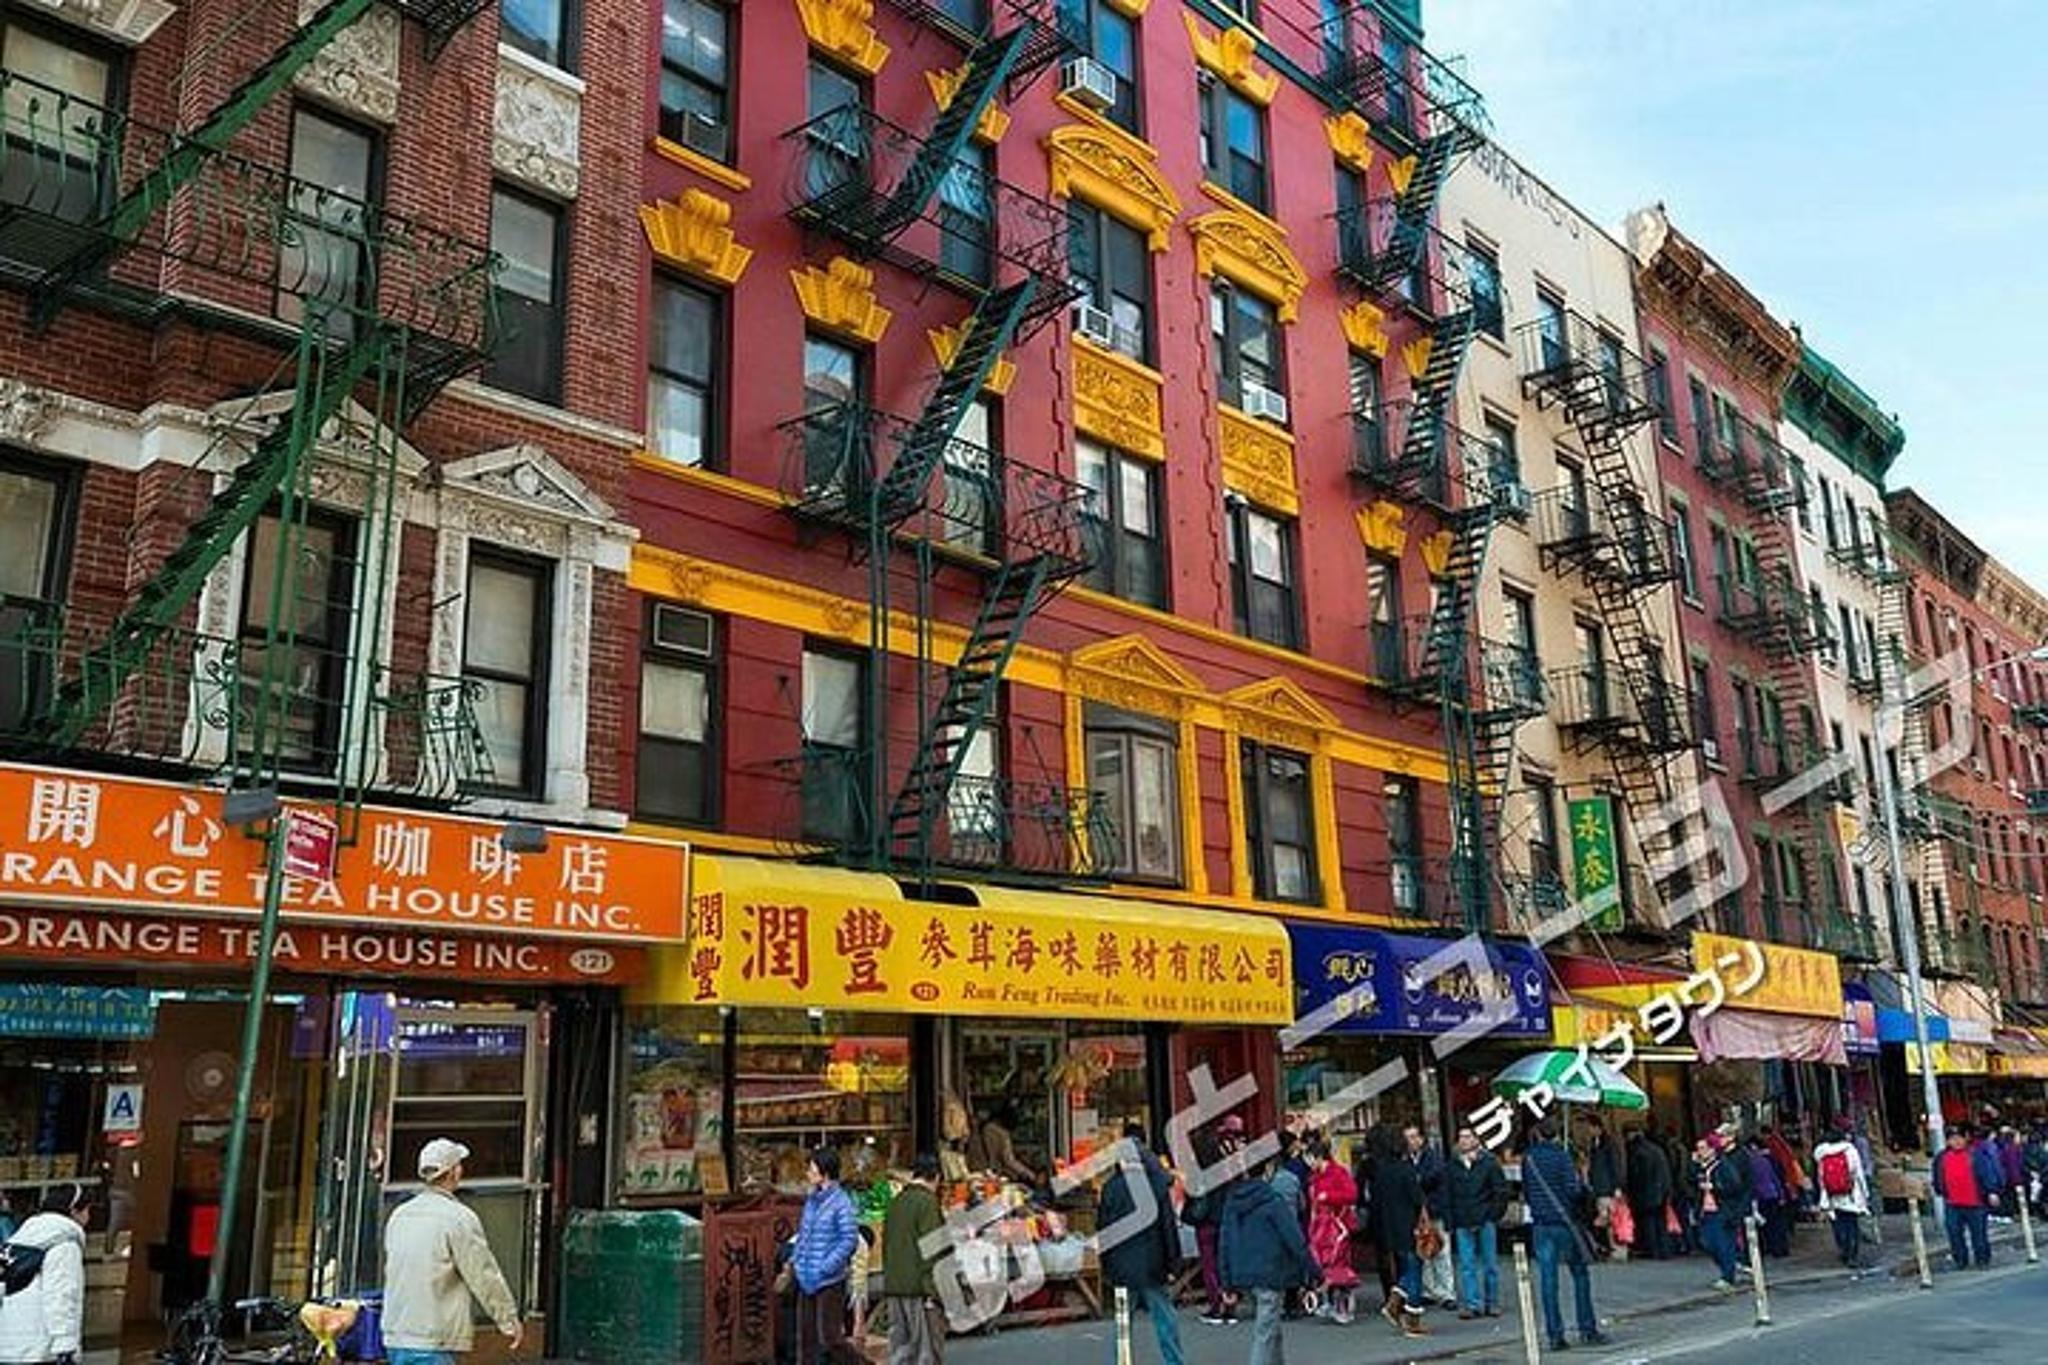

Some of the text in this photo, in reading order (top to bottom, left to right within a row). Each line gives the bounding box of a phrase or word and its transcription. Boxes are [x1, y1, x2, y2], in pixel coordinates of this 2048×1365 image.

[247, 871, 345, 908] TEA
[367, 884, 535, 922] HOUSE
[553, 900, 642, 931] INC.
[0, 914, 550, 972] ORANGE TEA HOUSE INC.
[690, 892, 724, 1001] 潤豐
[741, 903, 895, 996] 潤豐
[1045, 985, 1100, 1007] Trading
[111, 1091, 134, 1117] A
